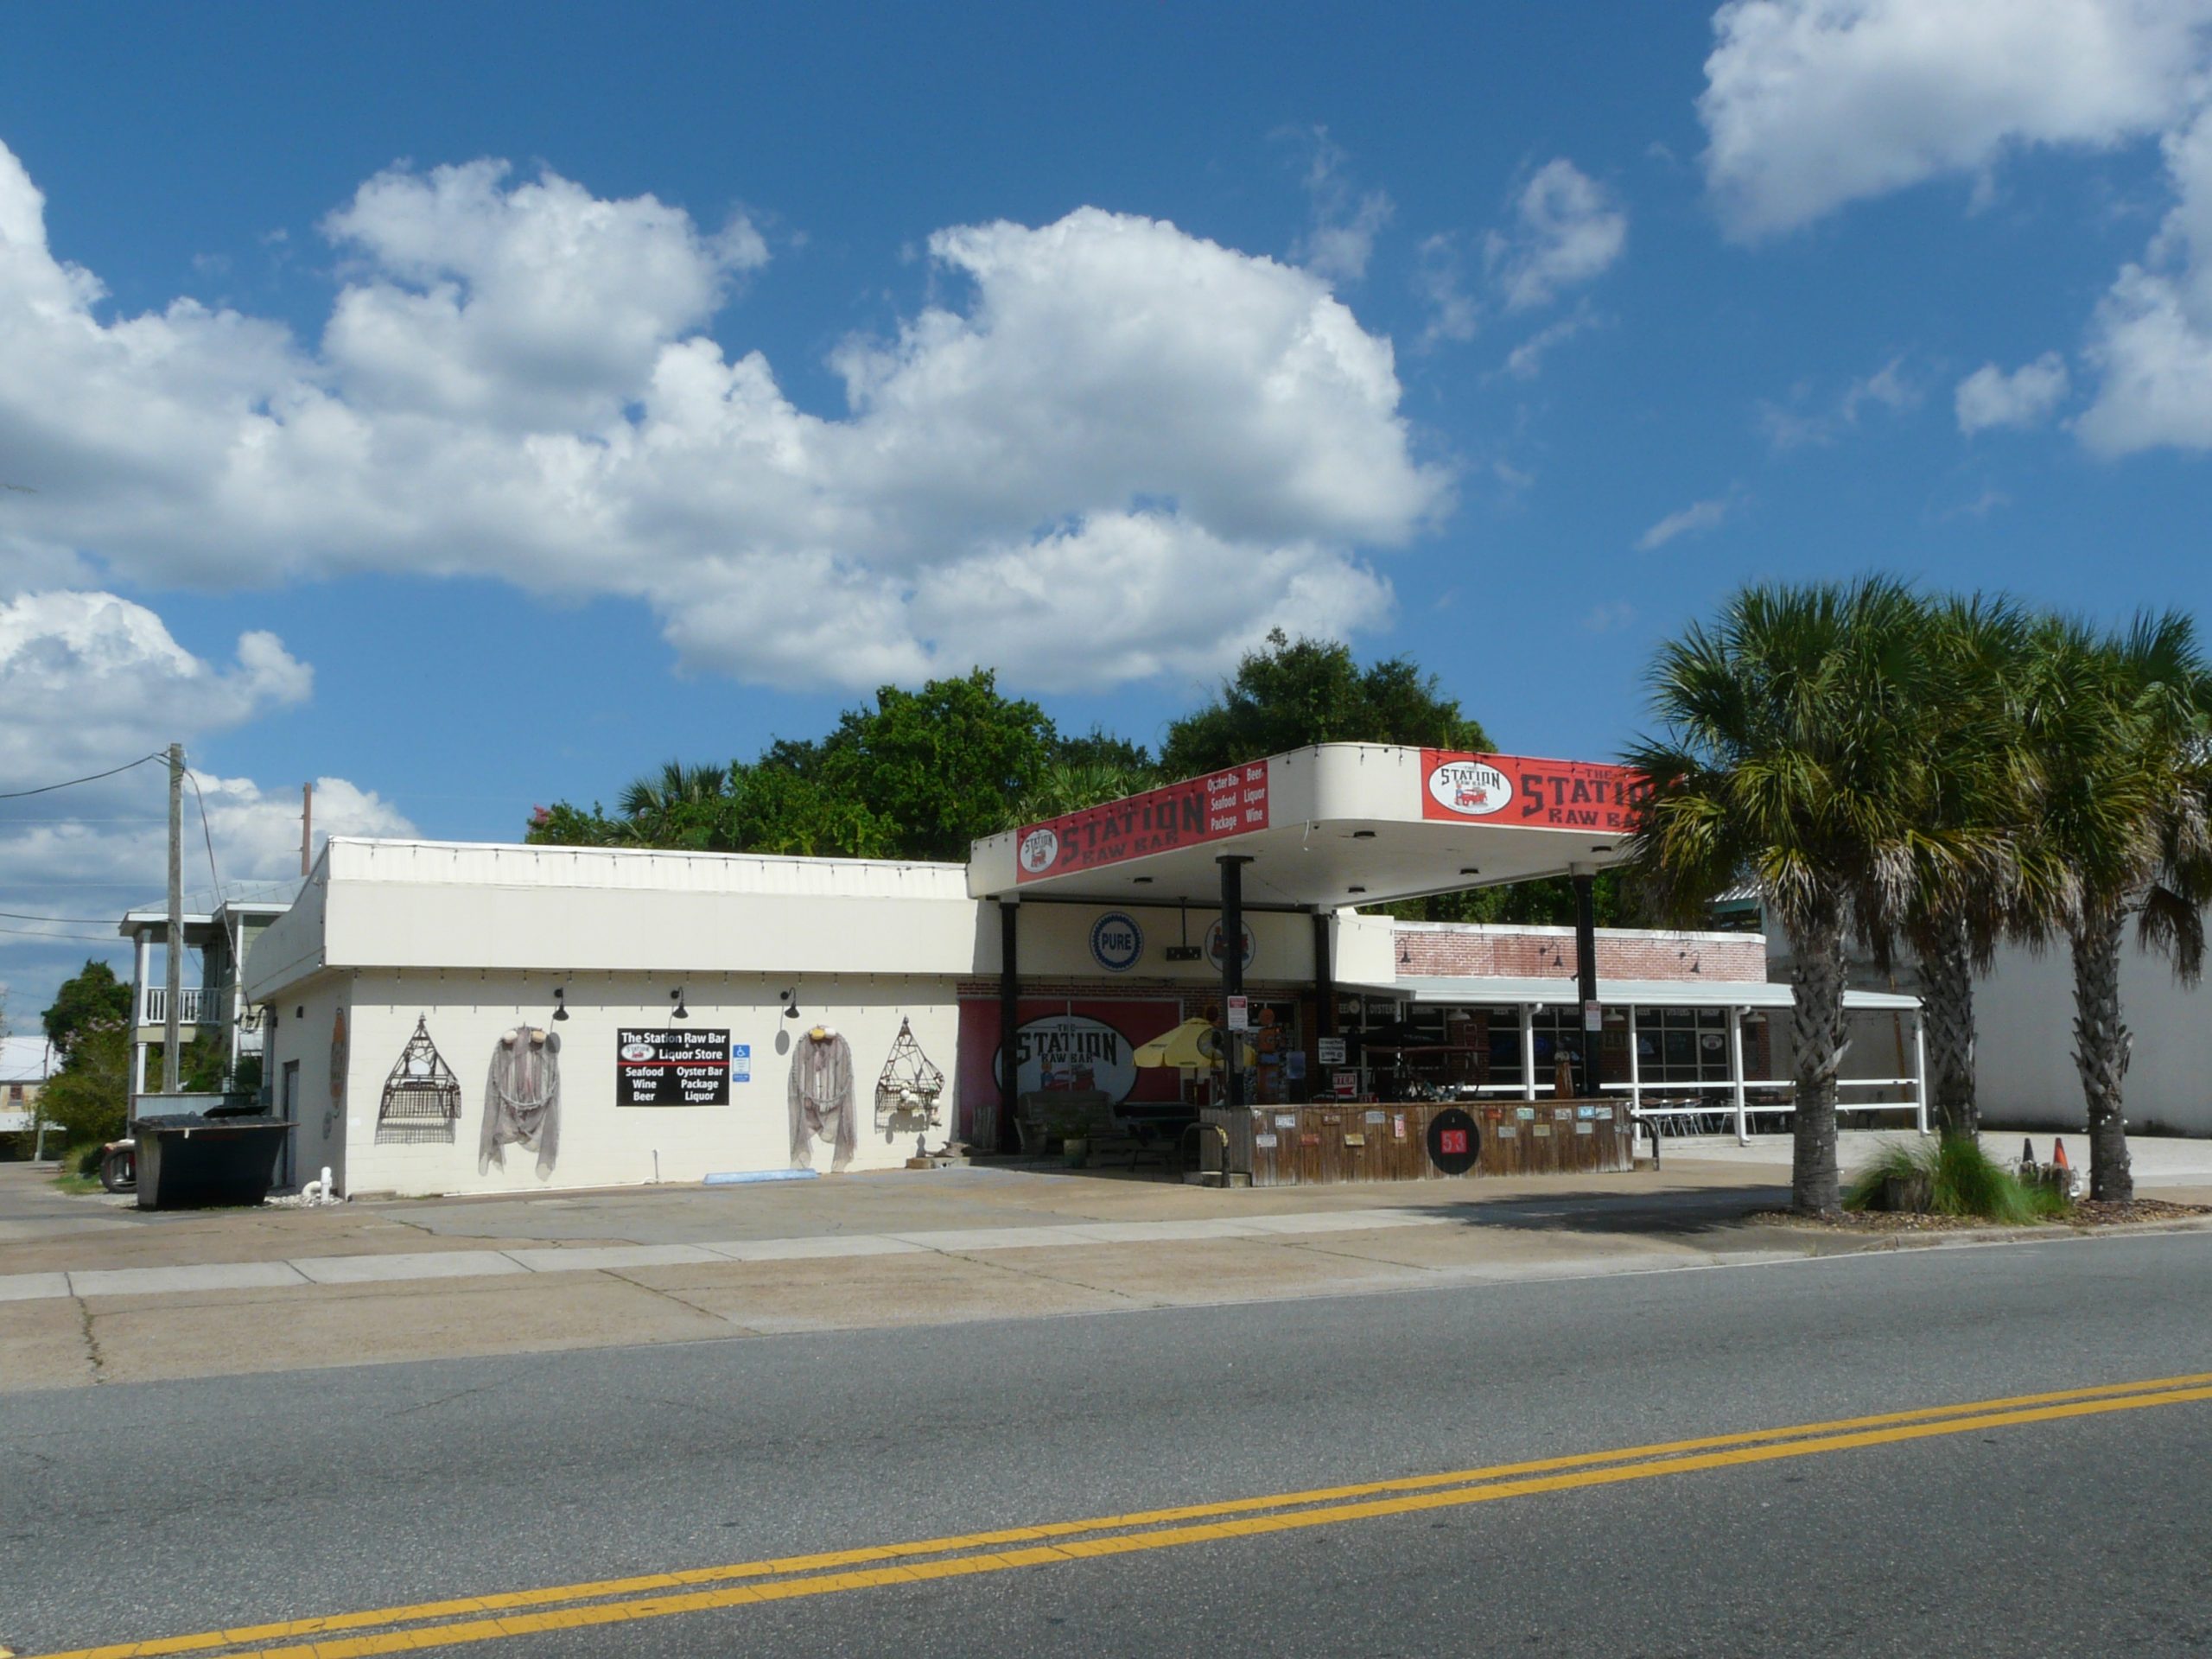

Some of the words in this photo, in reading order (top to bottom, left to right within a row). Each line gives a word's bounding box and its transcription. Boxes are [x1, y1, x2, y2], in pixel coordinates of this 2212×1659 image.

[1247, 768, 1263, 782] Beer
[1441, 768, 1500, 791] STATION
[1585, 768, 1613, 779] THE
[1207, 777, 1227, 794] Oyster
[1211, 792, 1236, 811] Seafood
[1244, 788, 1265, 804] Liquor
[1521, 773, 1649, 818] STATIO
[1246, 808, 1262, 823] Wine
[1548, 808, 1599, 826] RAW
[1061, 792, 1205, 867] STATION
[1211, 816, 1236, 830] Package
[1025, 834, 1053, 854] STATION
[1102, 933, 1132, 950] PURE
[621, 1033, 642, 1044] The
[644, 1032, 682, 1044] Station
[684, 1033, 706, 1044] Raw
[708, 1032, 726, 1044] Bar
[658, 1049, 693, 1061] Liquor
[695, 1048, 723, 1059] Store
[1017, 1032, 1117, 1066] STATION
[1042, 1053, 1066, 1064] RAW
[1071, 1052, 1093, 1064] BAR
[626, 1067, 664, 1077] Seafood
[677, 1066, 706, 1077] Oyster
[708, 1066, 723, 1077] Bar
[632, 1079, 657, 1089] Wine
[681, 1079, 719, 1090] Package
[633, 1091, 655, 1102] Beer
[684, 1091, 715, 1103] Liquor
[1443, 1133, 1465, 1153] 53
